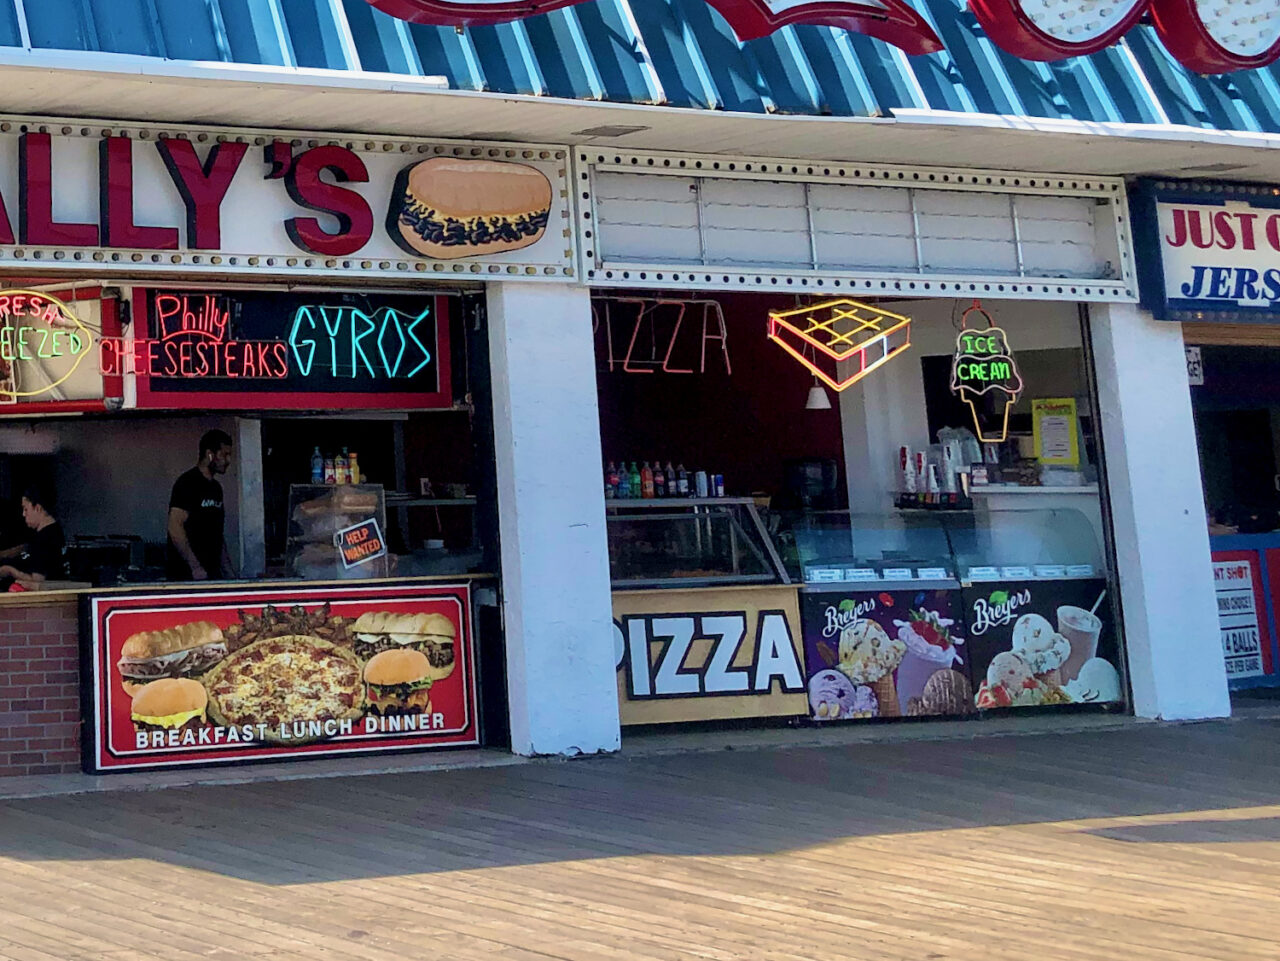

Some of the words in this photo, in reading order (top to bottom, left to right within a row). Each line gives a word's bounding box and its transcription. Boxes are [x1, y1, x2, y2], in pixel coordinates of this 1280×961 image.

[1166, 209, 1258, 250] JUST
[155, 295, 229, 341] Philly
[289, 306, 430, 378] GYROS
[592, 299, 732, 375] IZZA
[962, 336, 999, 354] ICE
[100, 340, 288, 377] CHEESESTEAKS
[957, 361, 1011, 381] CREAM
[344, 538, 380, 560] WANTED
[345, 528, 369, 545] HELP
[1227, 566, 1248, 579] SHOT
[822, 598, 876, 638] Breyers
[971, 589, 1031, 636] Breyers
[1232, 630, 1258, 653] BALLS
[136, 723, 269, 749] BREAKFAST
[280, 716, 353, 739] LUNCH
[365, 712, 445, 734] DINNER
